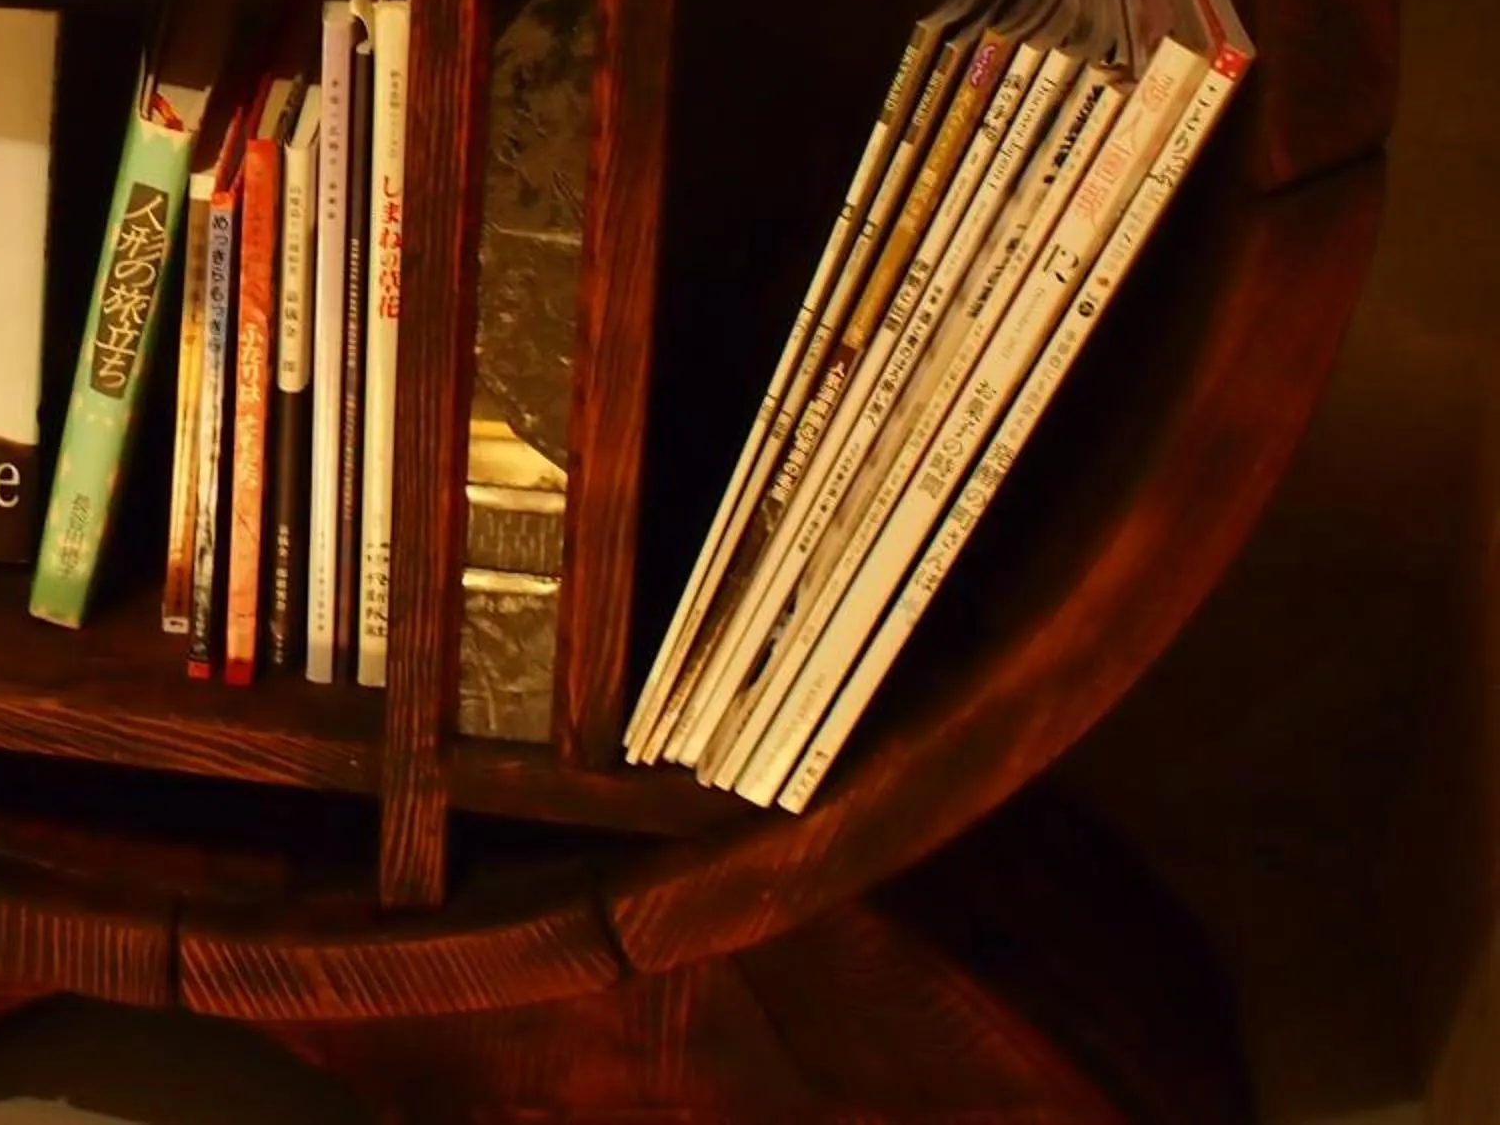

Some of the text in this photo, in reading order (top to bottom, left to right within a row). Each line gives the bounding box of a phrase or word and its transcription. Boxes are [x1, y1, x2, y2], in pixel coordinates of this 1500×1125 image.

[94, 195, 166, 388] 人形の旅立ち
